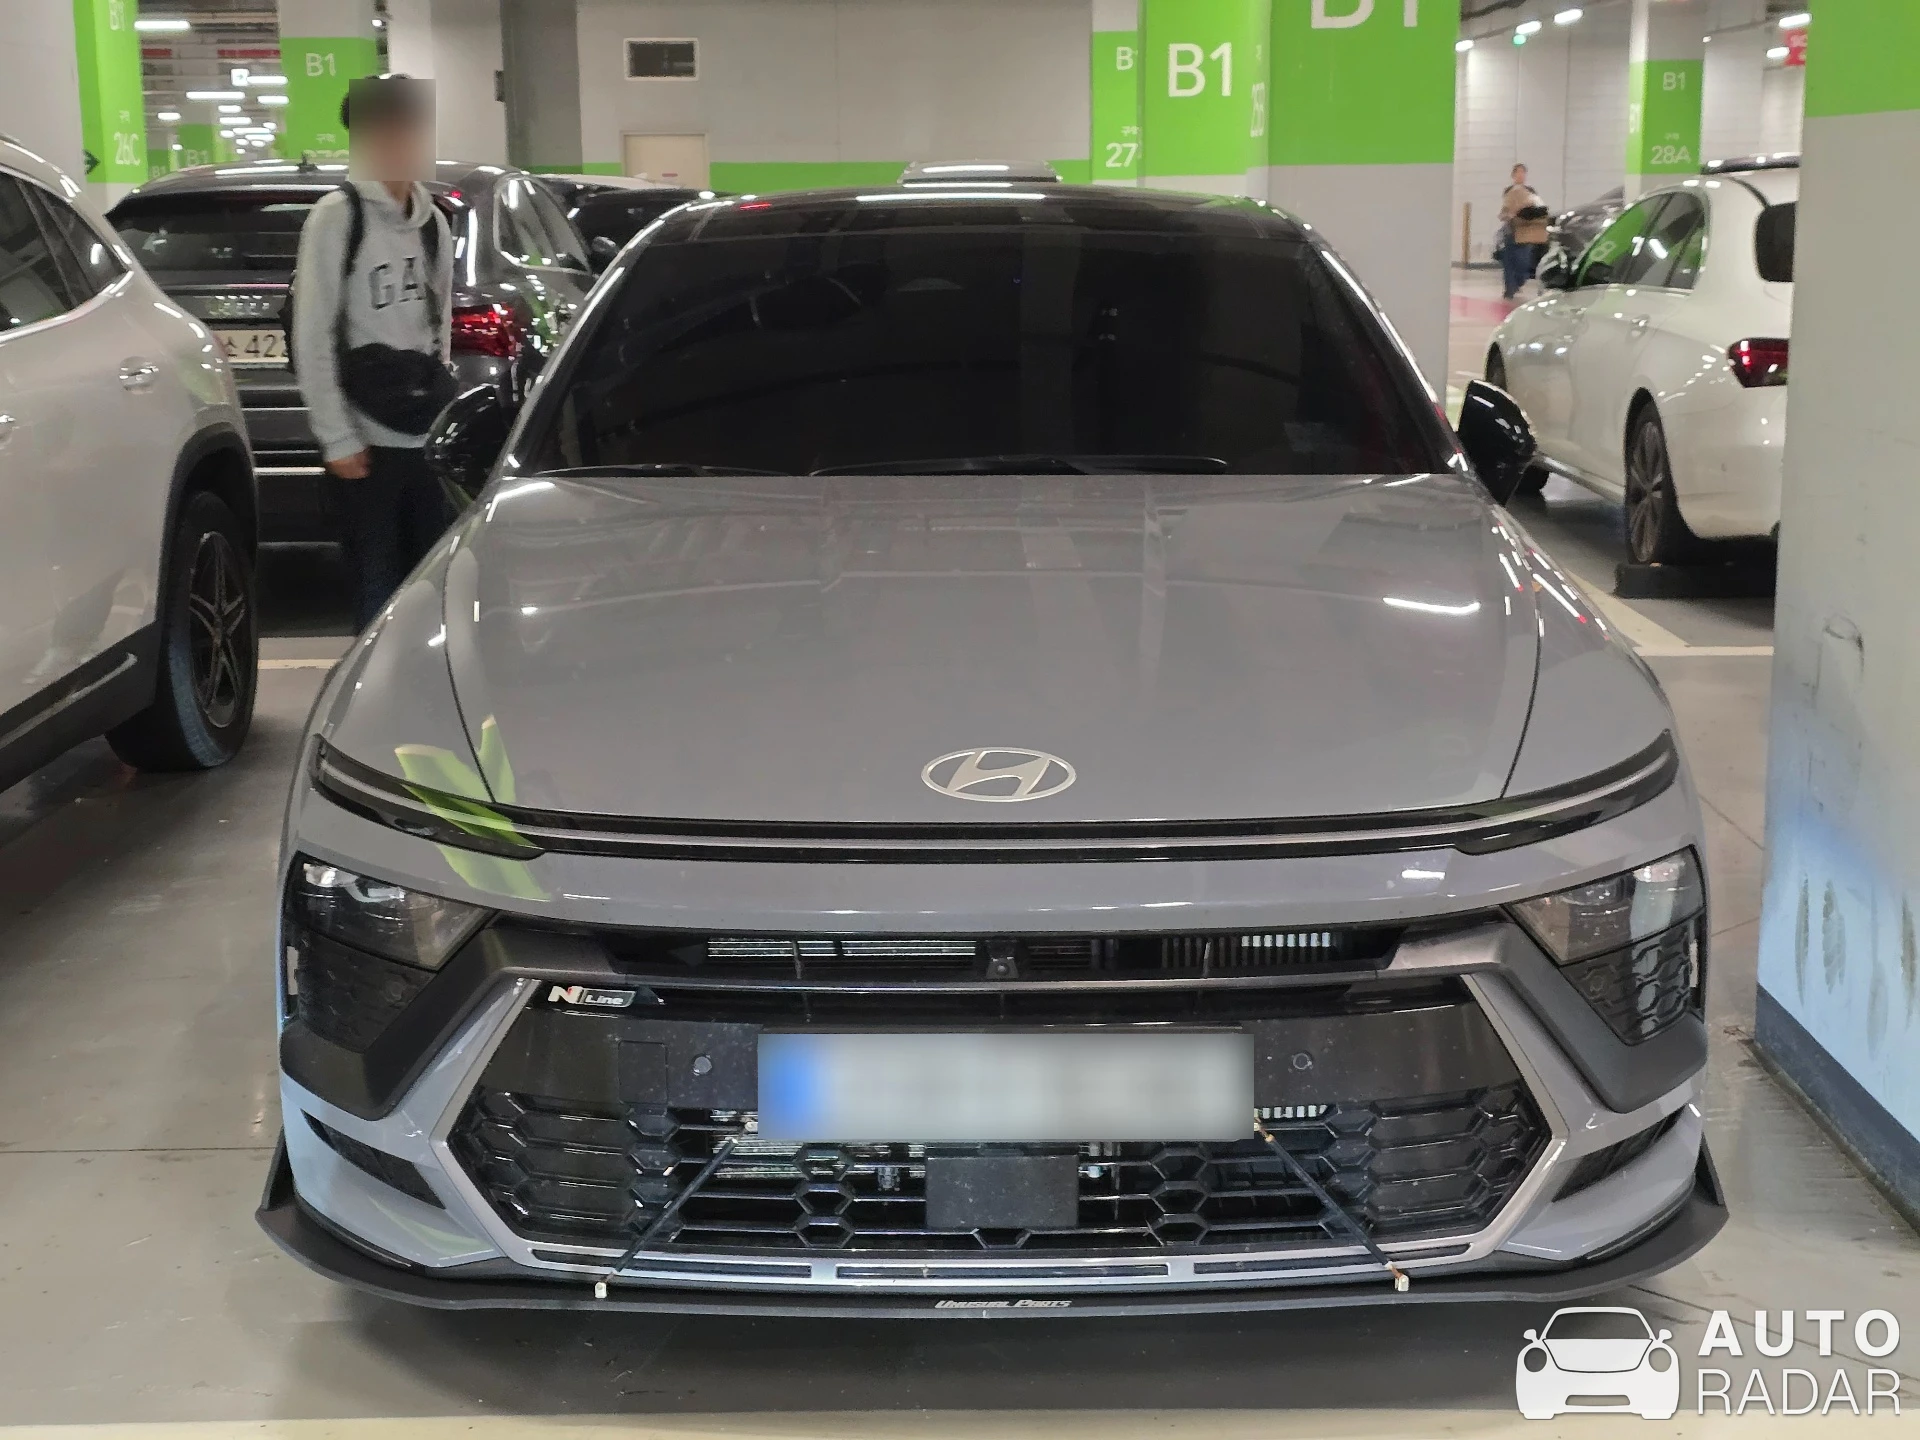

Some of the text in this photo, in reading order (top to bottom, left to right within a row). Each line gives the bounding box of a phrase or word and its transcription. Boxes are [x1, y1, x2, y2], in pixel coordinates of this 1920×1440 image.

[305, 52, 337, 77] B1
[1115, 46, 1138, 71] B
[1168, 42, 1233, 98] B1
[1662, 71, 1686, 91] B1
[113, 131, 141, 166] 26C
[1650, 144, 1691, 165] 28A
[368, 255, 425, 311] GA
[585, 994, 624, 1005] Line
